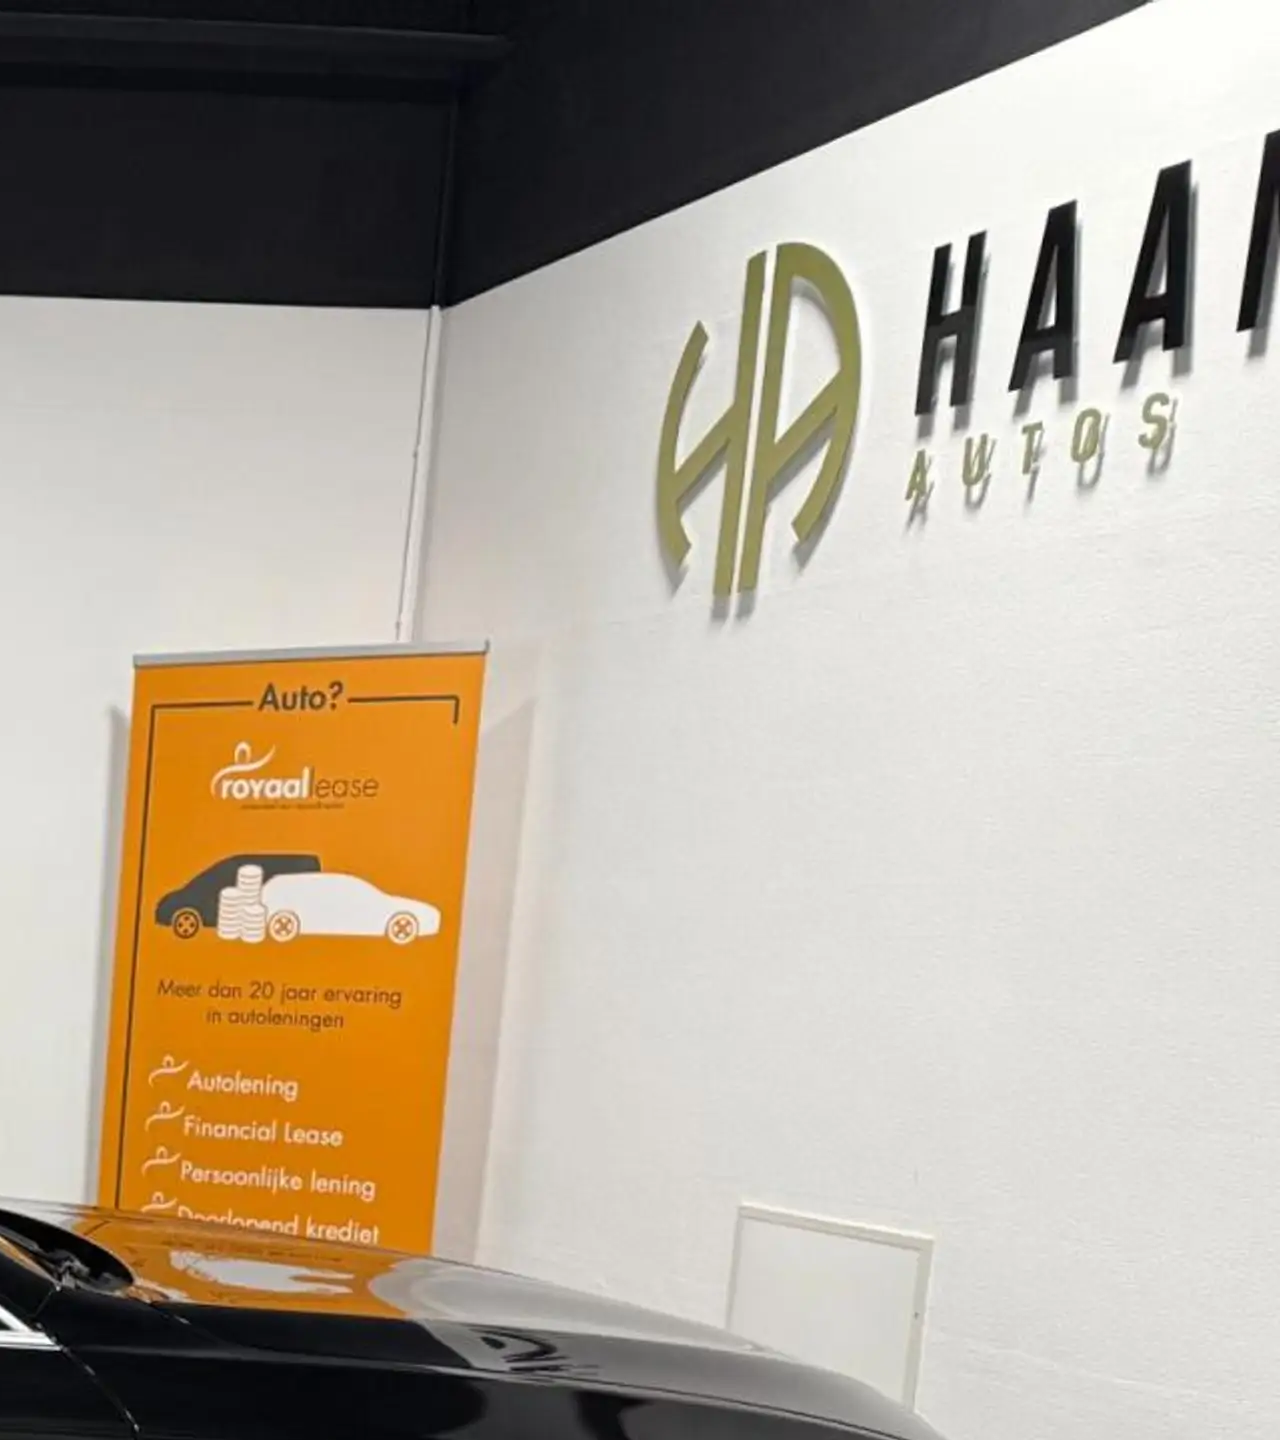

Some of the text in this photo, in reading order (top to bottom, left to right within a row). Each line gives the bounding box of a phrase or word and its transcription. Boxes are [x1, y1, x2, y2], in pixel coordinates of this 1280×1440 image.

[904, 392, 1173, 502] AUTOS
[257, 680, 345, 712] Auto?
[157, 979, 402, 1009] Meer dan 20 jaar ervaring
[206, 1007, 344, 1032] in autoleningen
[187, 1070, 299, 1102] Autolening
[183, 1114, 343, 1147] Financial Lease
[180, 1160, 376, 1202] Persoonlijke lening
[305, 1216, 380, 1244] krediet
